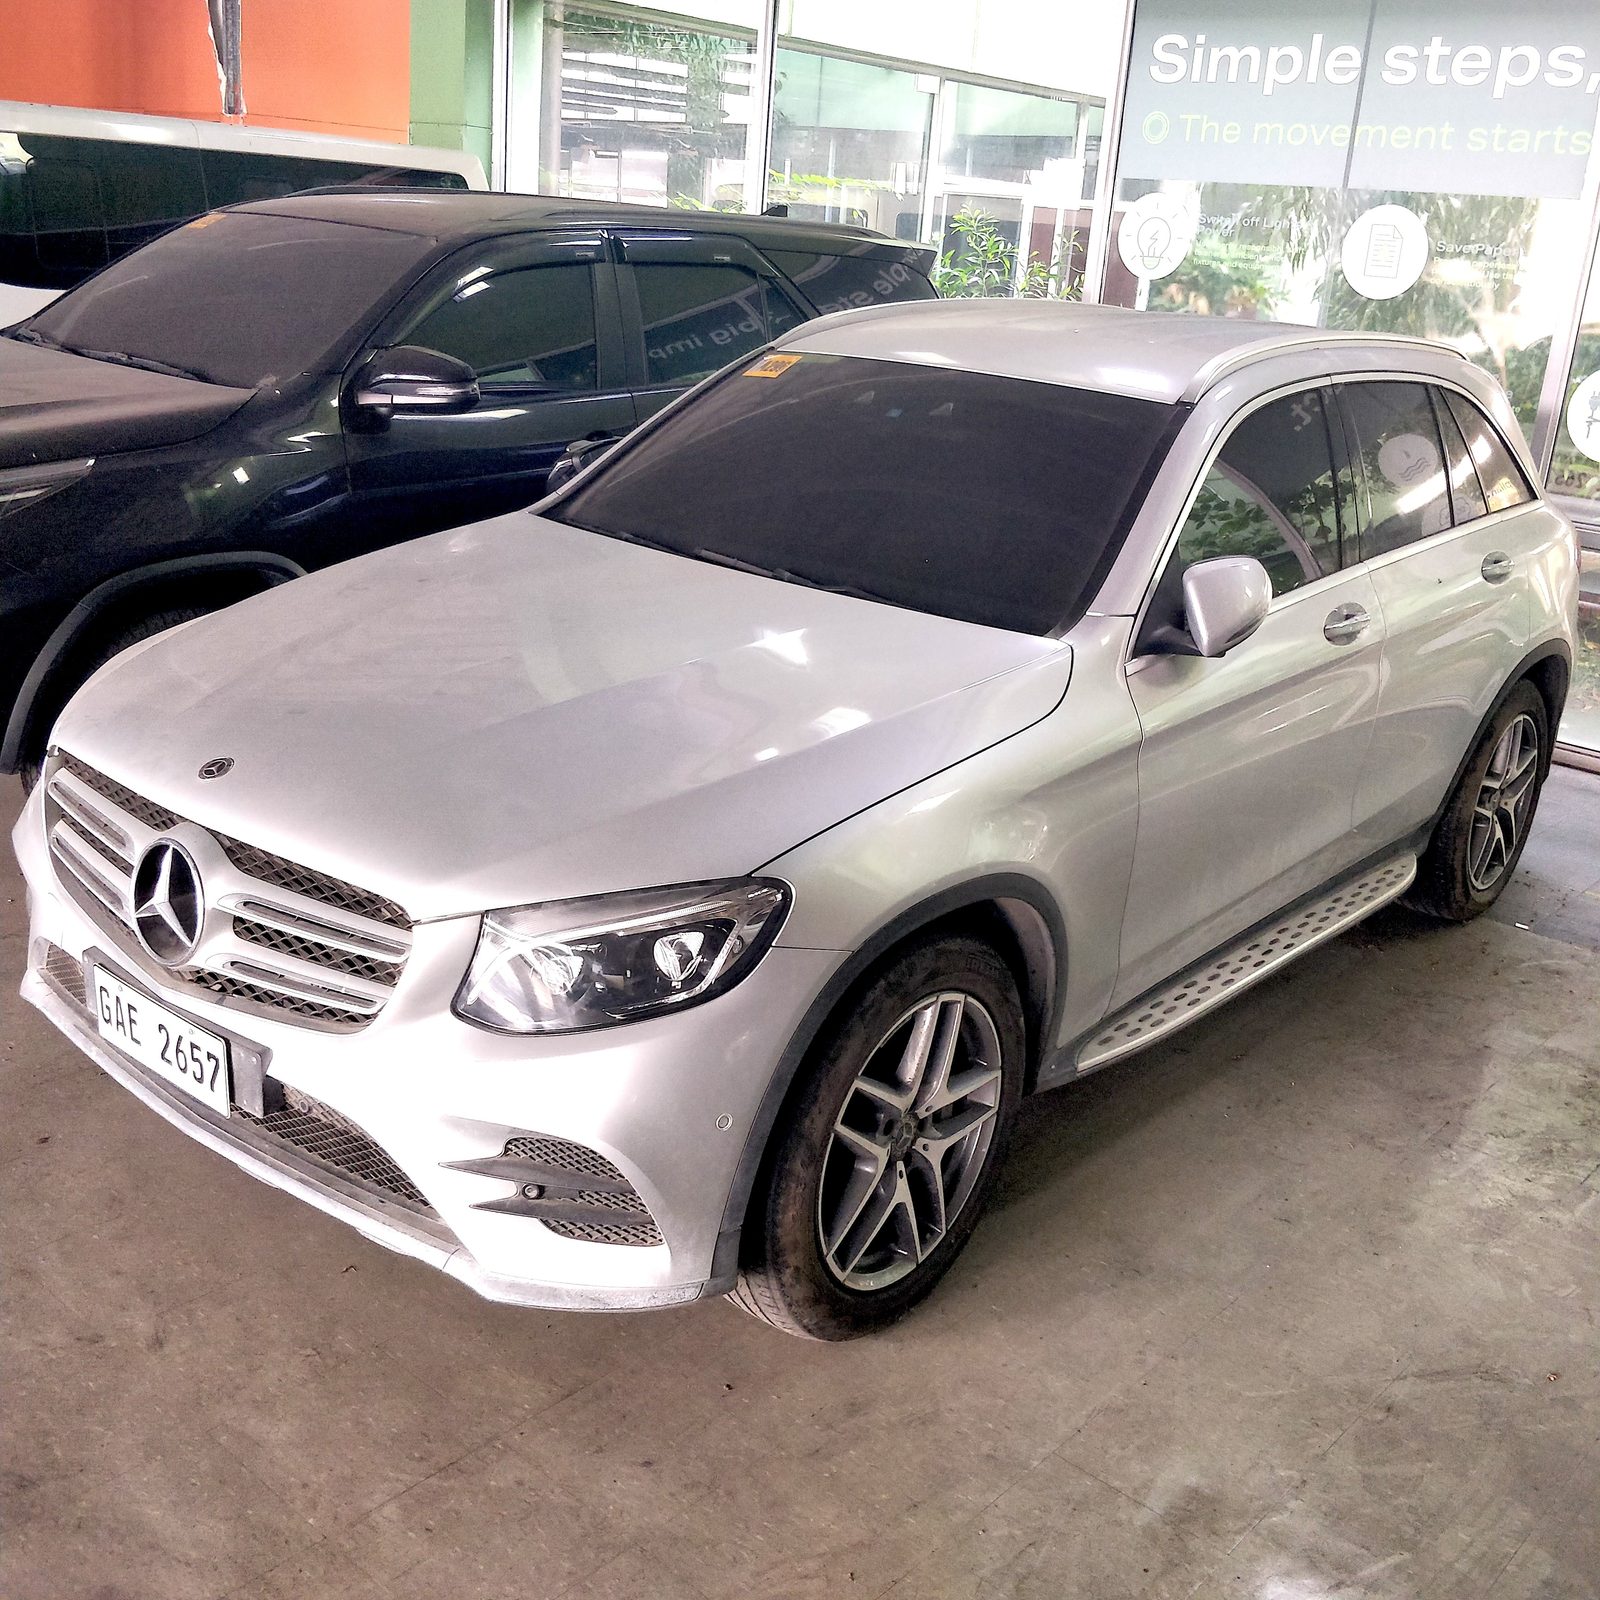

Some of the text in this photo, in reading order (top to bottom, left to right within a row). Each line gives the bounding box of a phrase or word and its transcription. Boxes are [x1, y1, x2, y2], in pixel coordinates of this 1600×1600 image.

[1149, 33, 1600, 99] Simple steps,
[1179, 114, 1592, 157] The movement starts
[1242, 215, 1261, 227] off
[1436, 240, 1472, 254] Save
[99, 985, 220, 1093] GAE 2657
